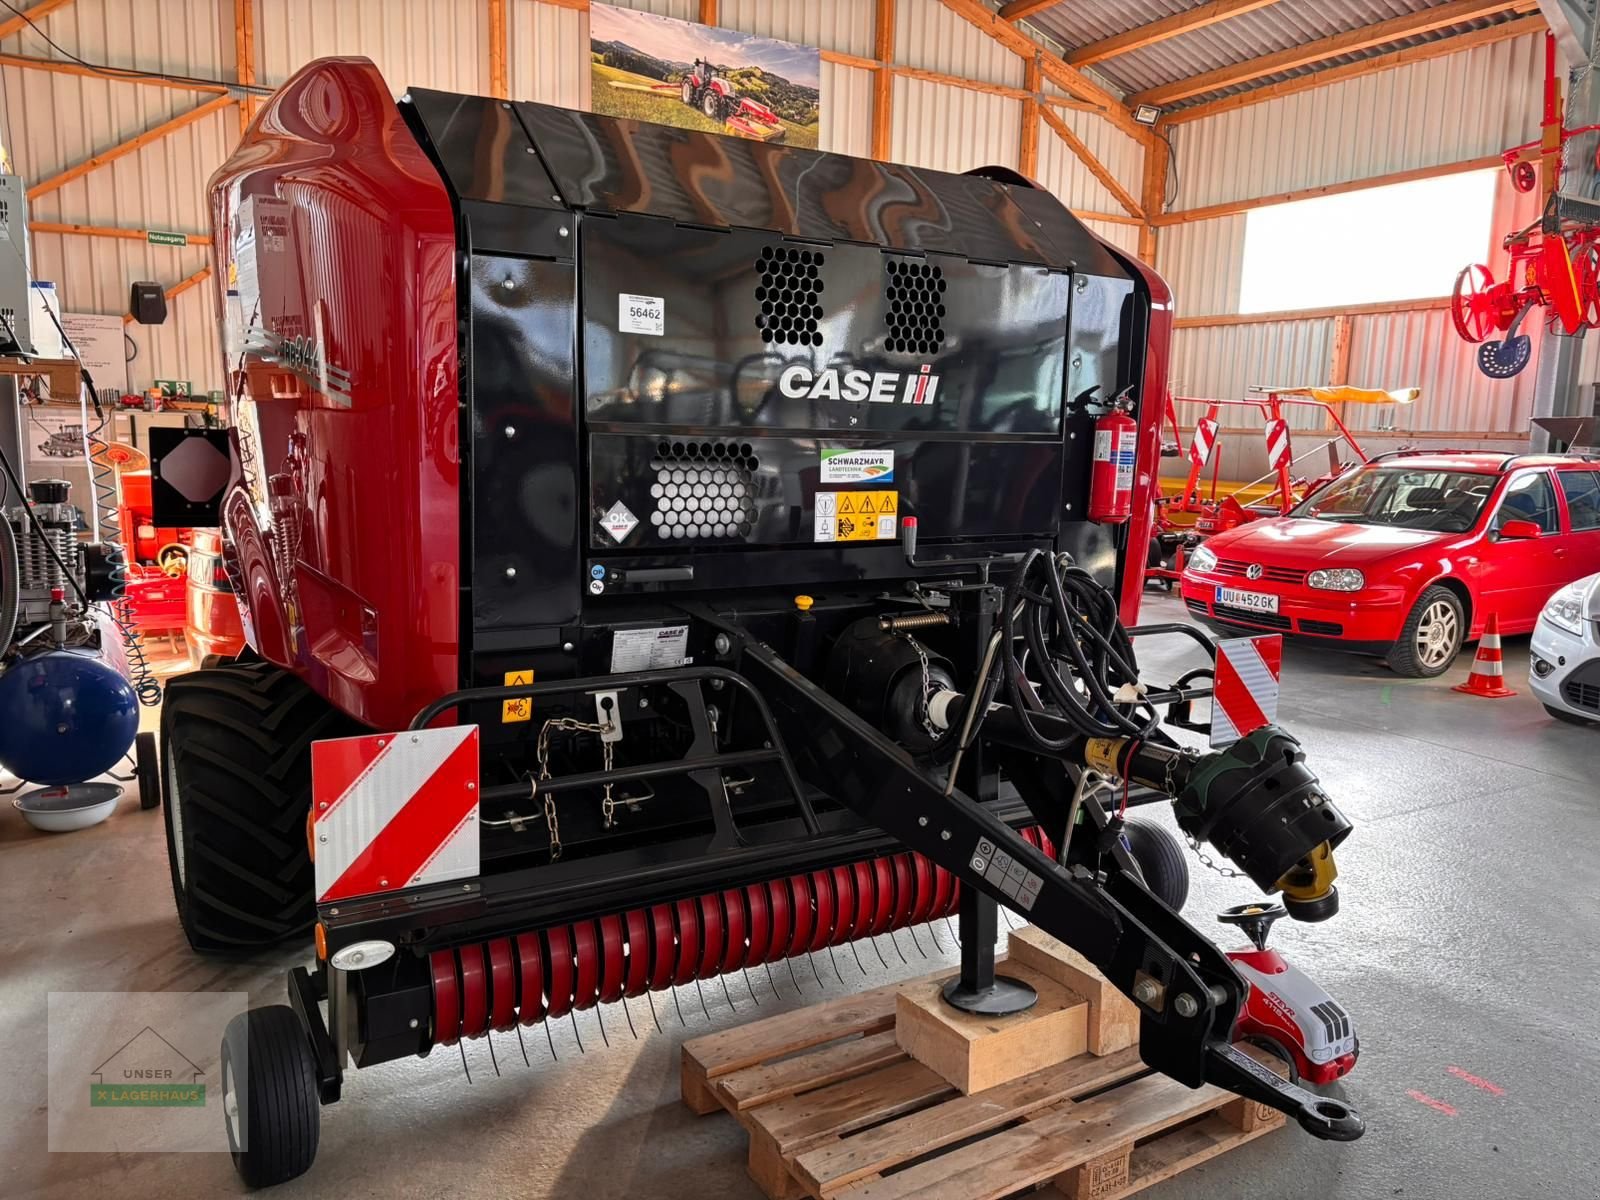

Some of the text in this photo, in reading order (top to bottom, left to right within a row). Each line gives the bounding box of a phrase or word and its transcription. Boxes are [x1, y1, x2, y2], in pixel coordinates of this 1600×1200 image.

[149, 233, 185, 244] Notausgang
[630, 306, 661, 320] 56462
[779, 365, 900, 403] CASE
[828, 457, 885, 465] SCHWARZMAYR
[609, 512, 628, 523] OK
[592, 568, 604, 576] OK
[591, 582, 603, 592] OK
[1223, 590, 1274, 609] UU 452 GK
[1268, 991, 1296, 1016] STEYR
